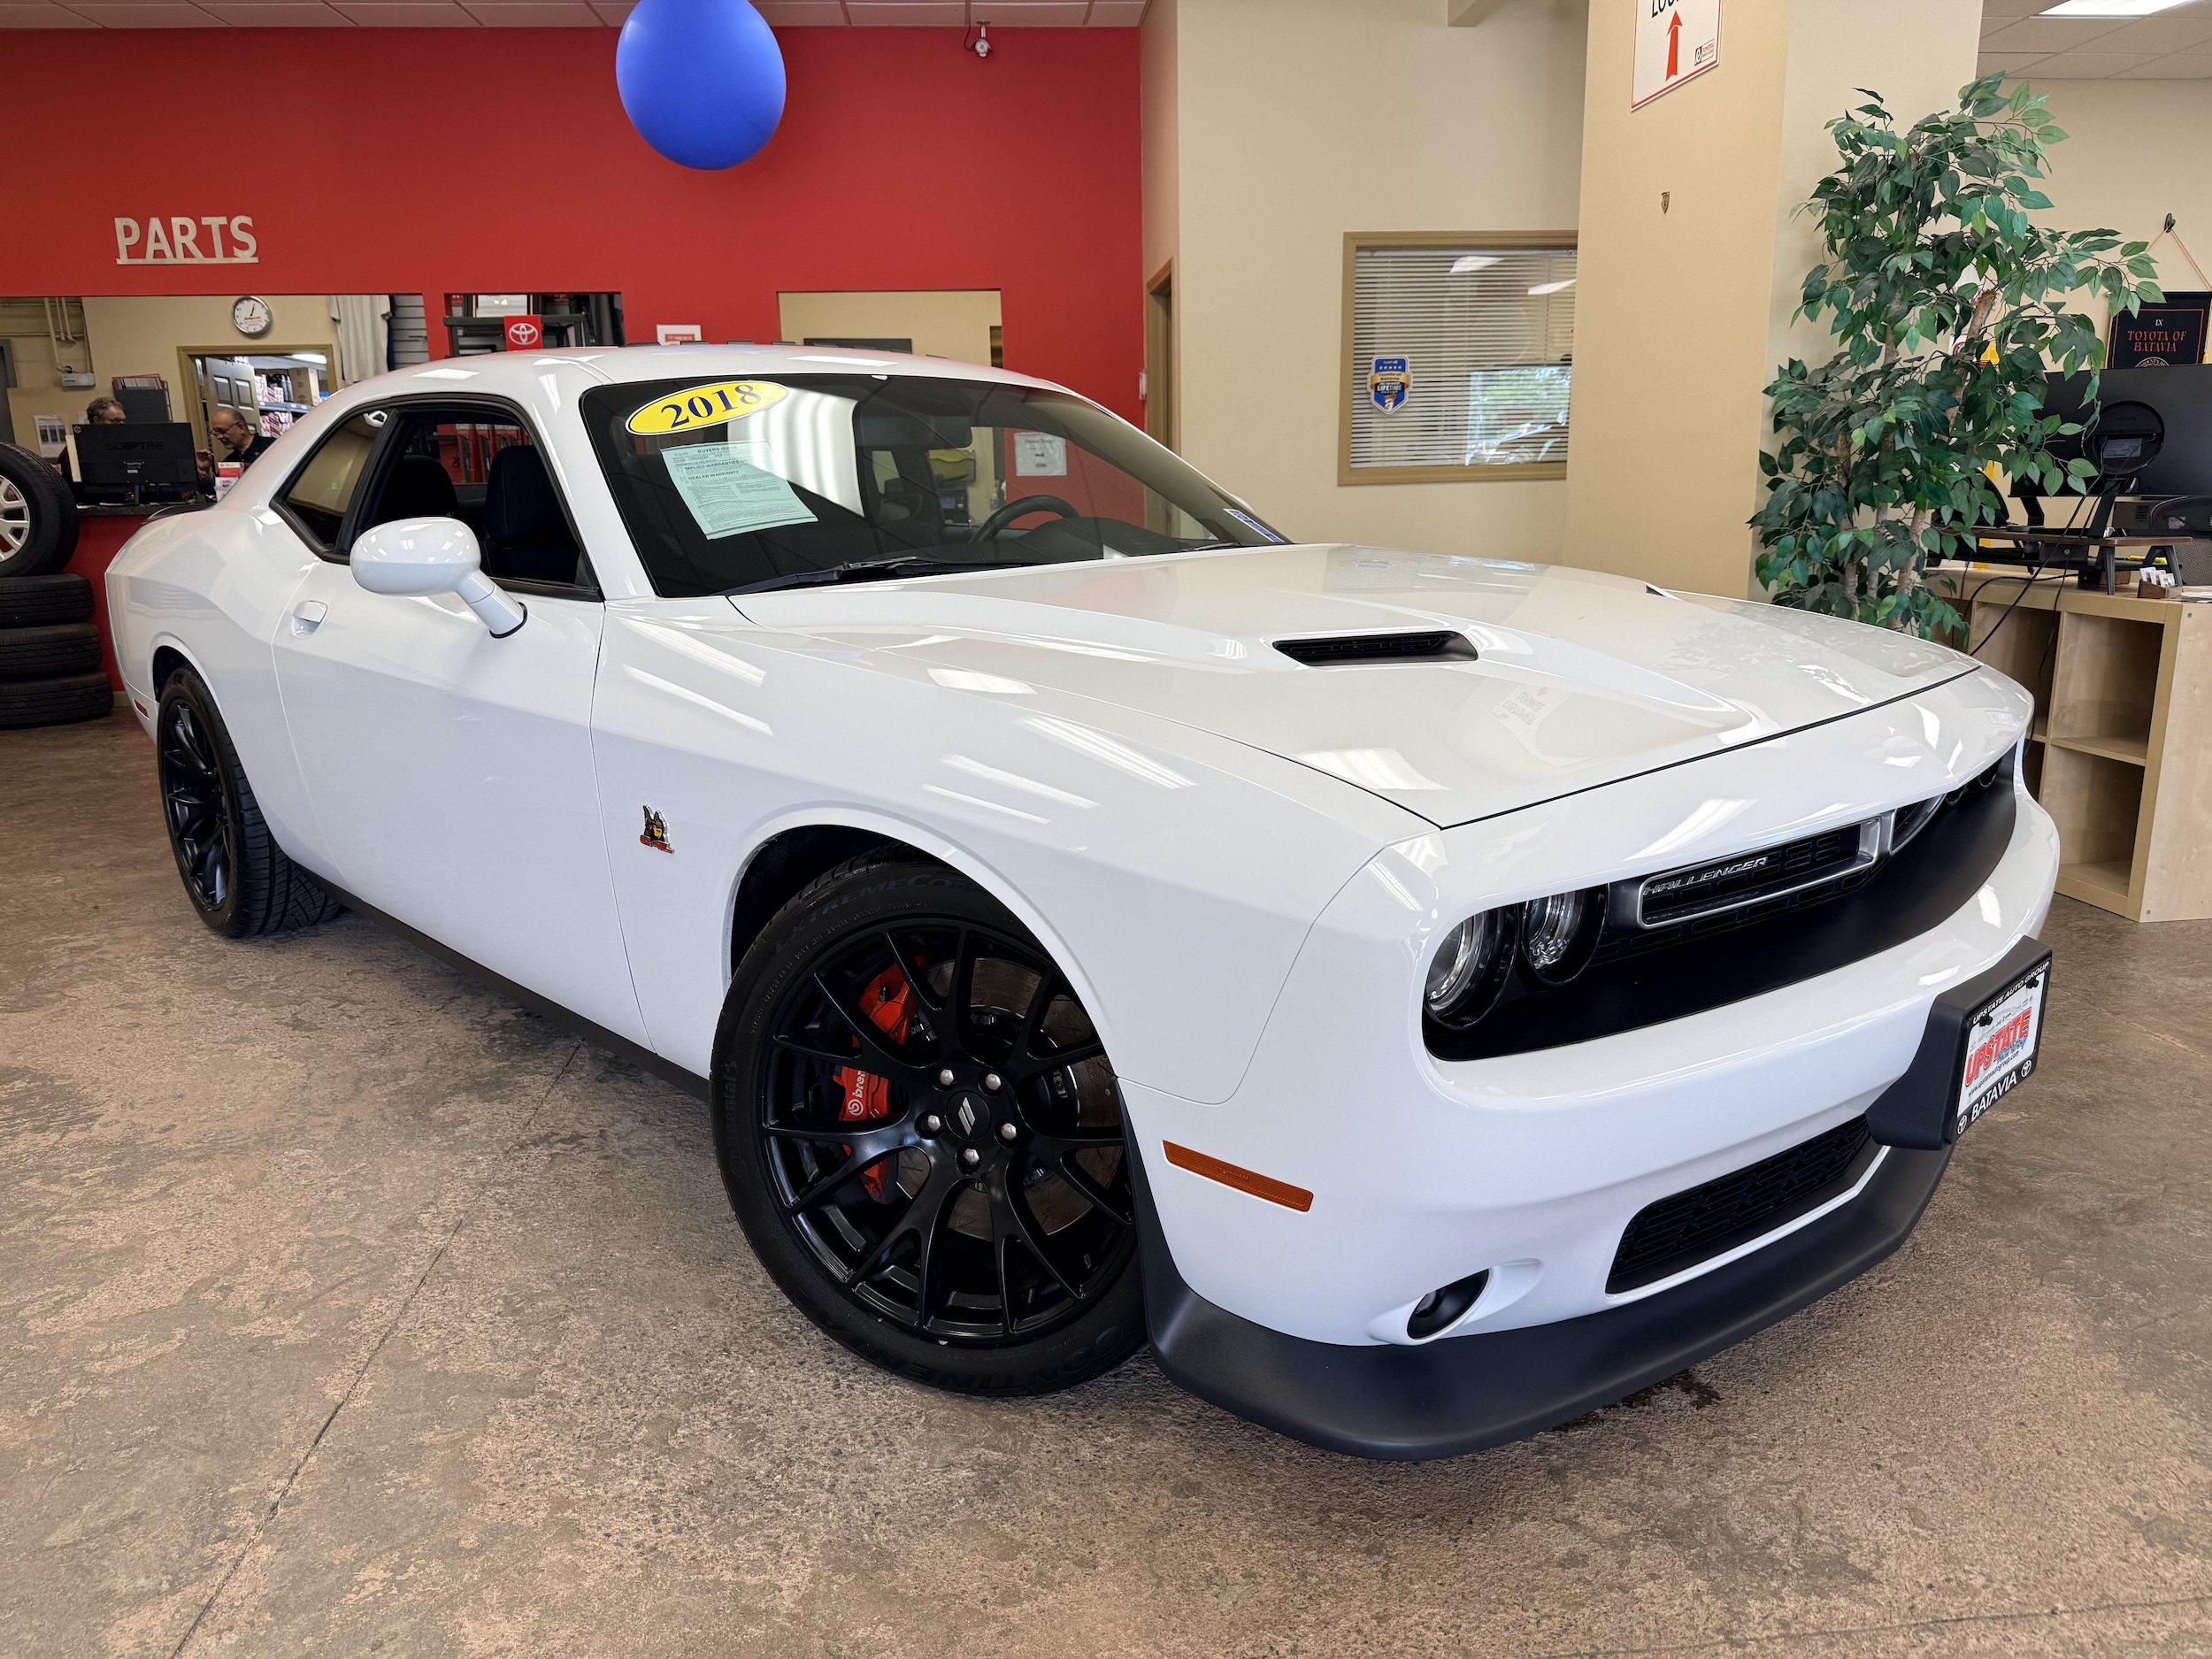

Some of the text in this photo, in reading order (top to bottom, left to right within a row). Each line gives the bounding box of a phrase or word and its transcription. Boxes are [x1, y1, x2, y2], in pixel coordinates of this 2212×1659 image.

[114, 215, 258, 264] PARTS
[2127, 330, 2187, 342] TOYOTA OF
[2133, 342, 2177, 352] BATAVIA
[661, 384, 762, 428] 2018
[1643, 856, 1769, 895] HALLENGER
[1972, 961, 2049, 1025] UPSTATE AUTO GROUP
[1964, 1007, 2032, 1087] UPSTATE
[1970, 1071, 2017, 1122] BATAVIA
